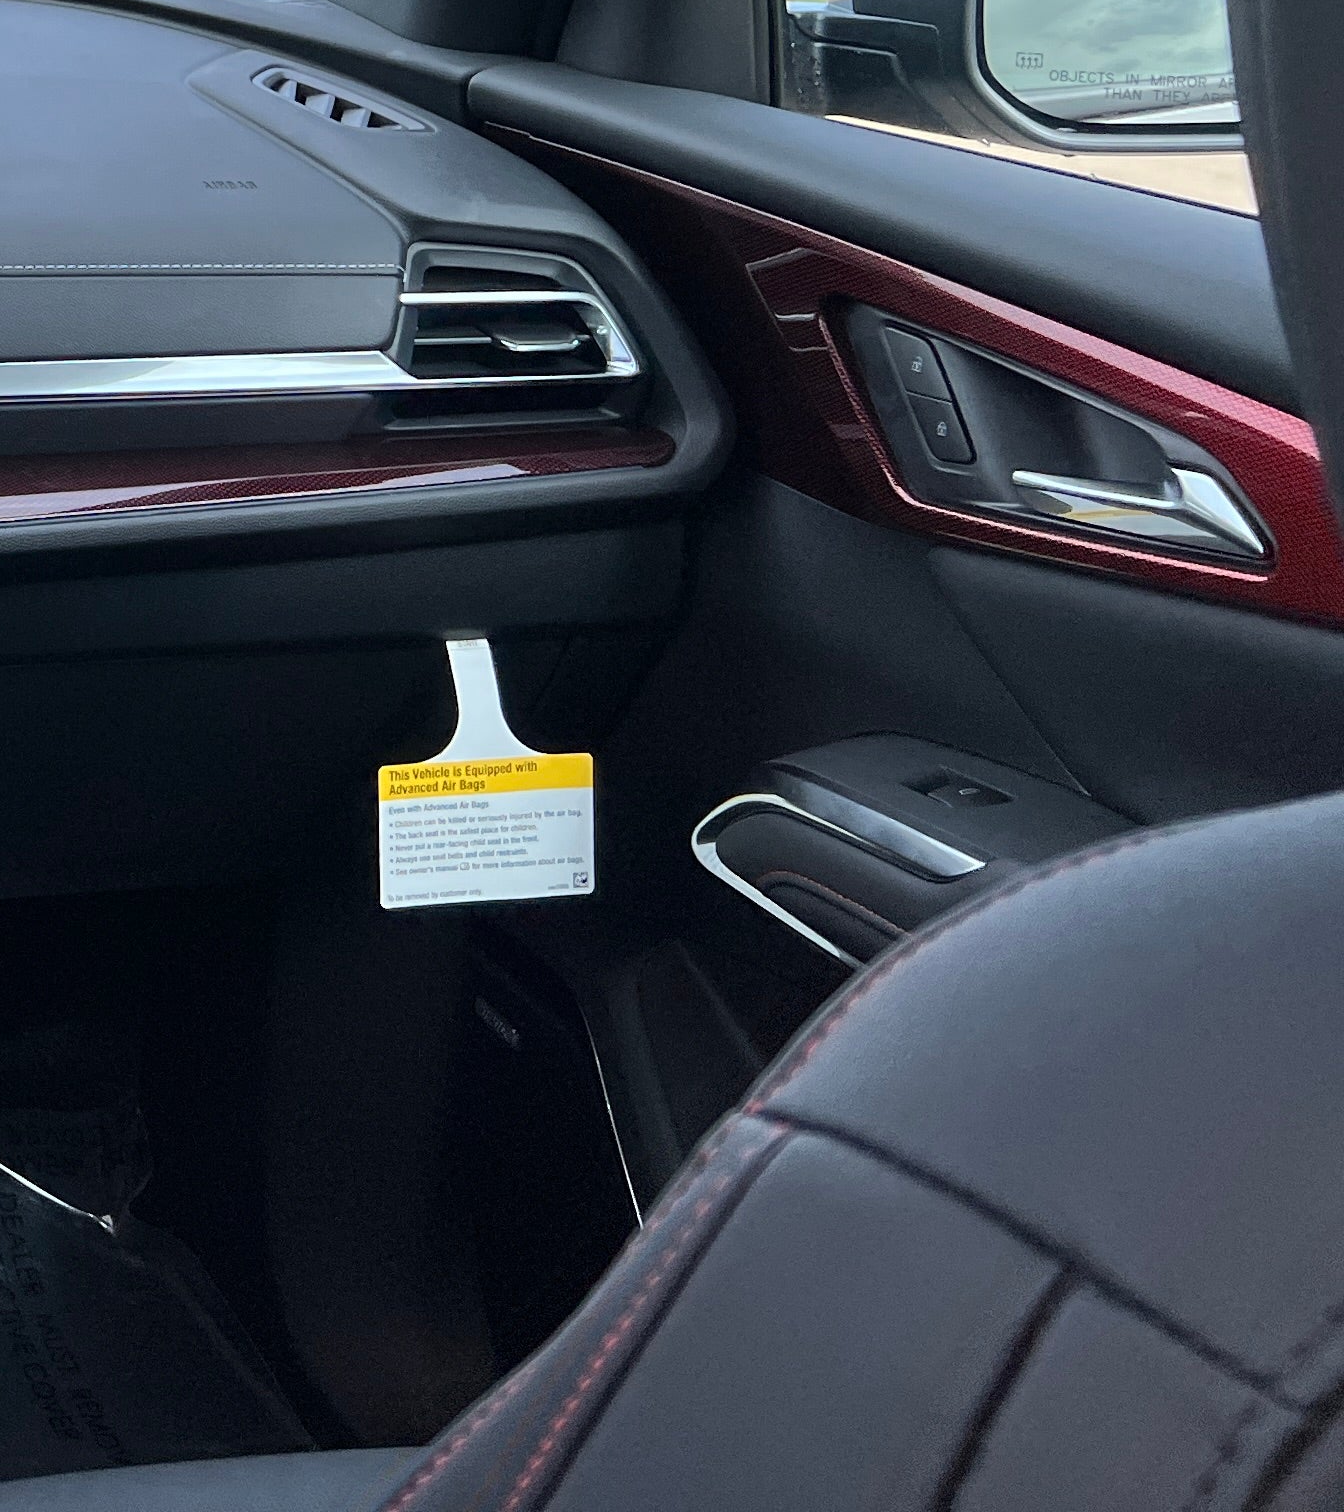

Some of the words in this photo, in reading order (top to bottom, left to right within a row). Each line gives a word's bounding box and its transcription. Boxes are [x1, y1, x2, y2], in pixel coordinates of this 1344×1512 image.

[1049, 70, 1114, 86] OBJECTS
[1126, 73, 1140, 86] IN
[1151, 75, 1208, 89] MIRROR
[1103, 87, 1143, 101] THAN
[1154, 89, 1191, 103] THEY
[389, 770, 410, 782] This
[412, 767, 450, 780] Vehicle
[465, 763, 513, 778] Equipped
[515, 761, 538, 773] with
[389, 782, 439, 796] Advanced
[441, 780, 457, 792] Air
[459, 779, 486, 792] Bags
[407, 804, 422, 814] with
[424, 802, 458, 813] Advanced
[459, 801, 469, 810] Air
[471, 800, 489, 810] Bags
